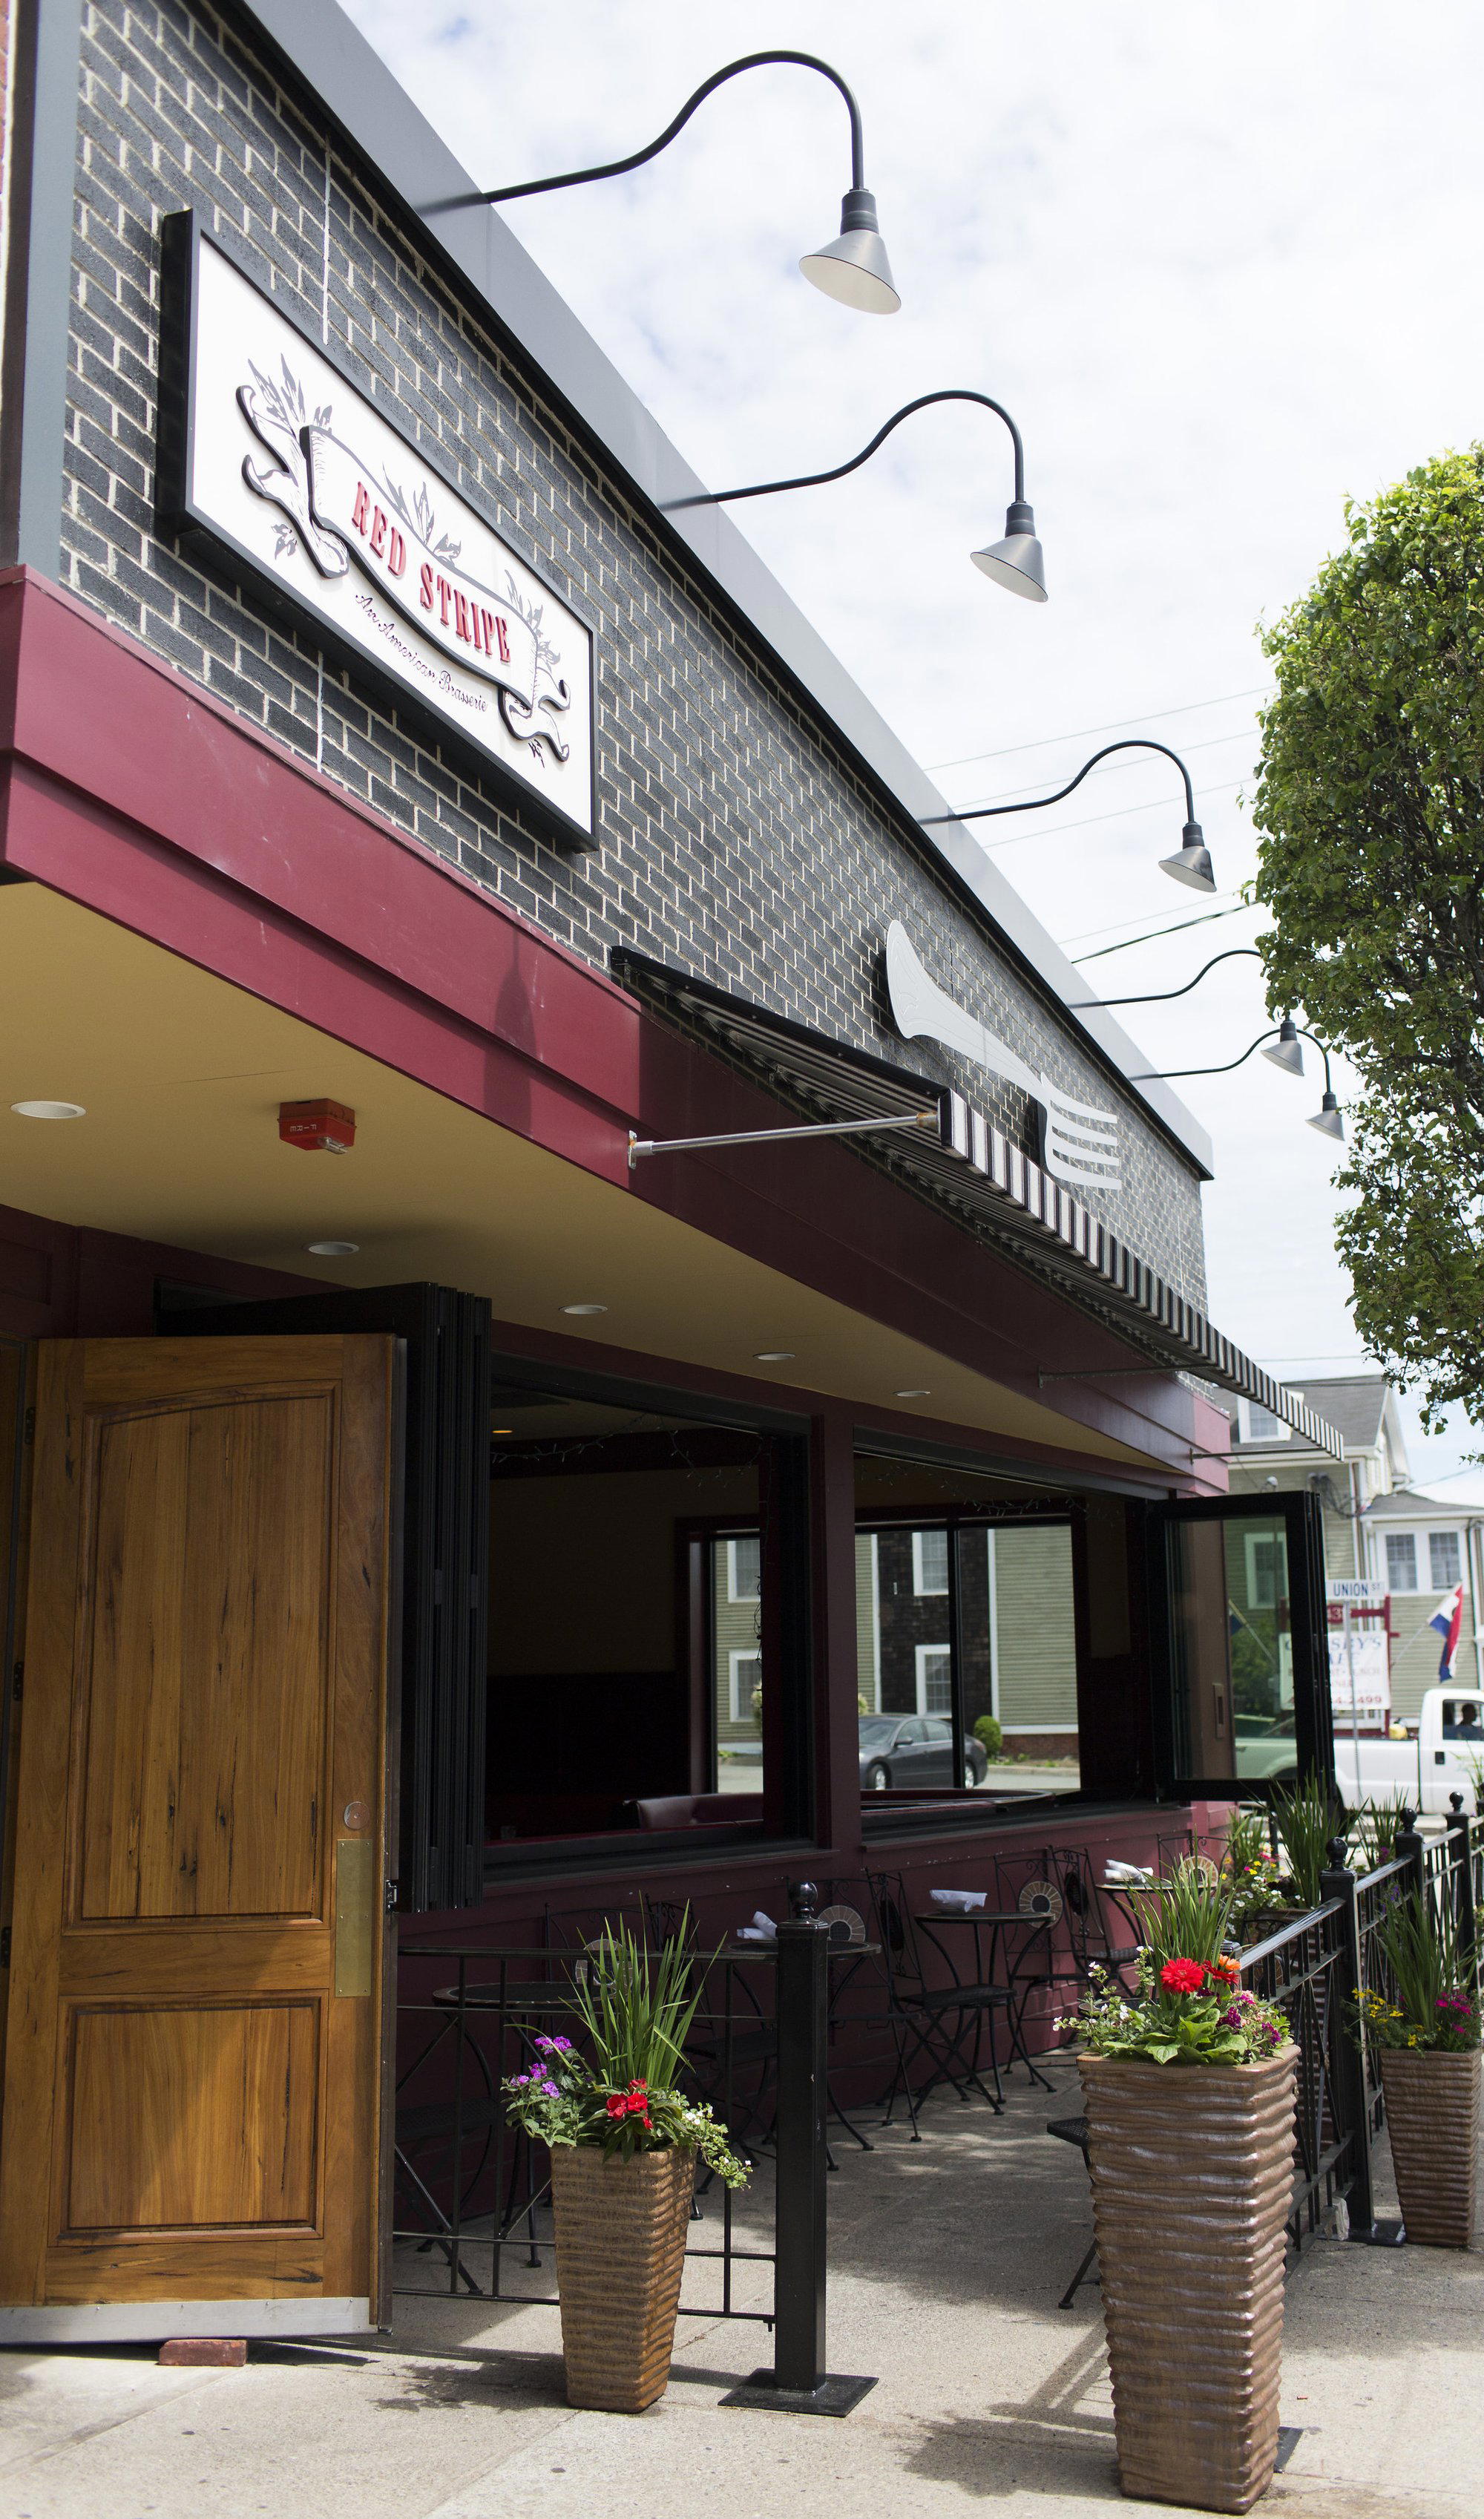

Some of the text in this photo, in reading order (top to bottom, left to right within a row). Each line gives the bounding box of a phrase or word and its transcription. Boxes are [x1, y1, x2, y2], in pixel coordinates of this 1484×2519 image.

[352, 482, 511, 663] RED STRIPE
[355, 594, 488, 712] An American Brasserie
[290, 1124, 317, 1133] FIRE
[1333, 1582, 1369, 1596] UNION
